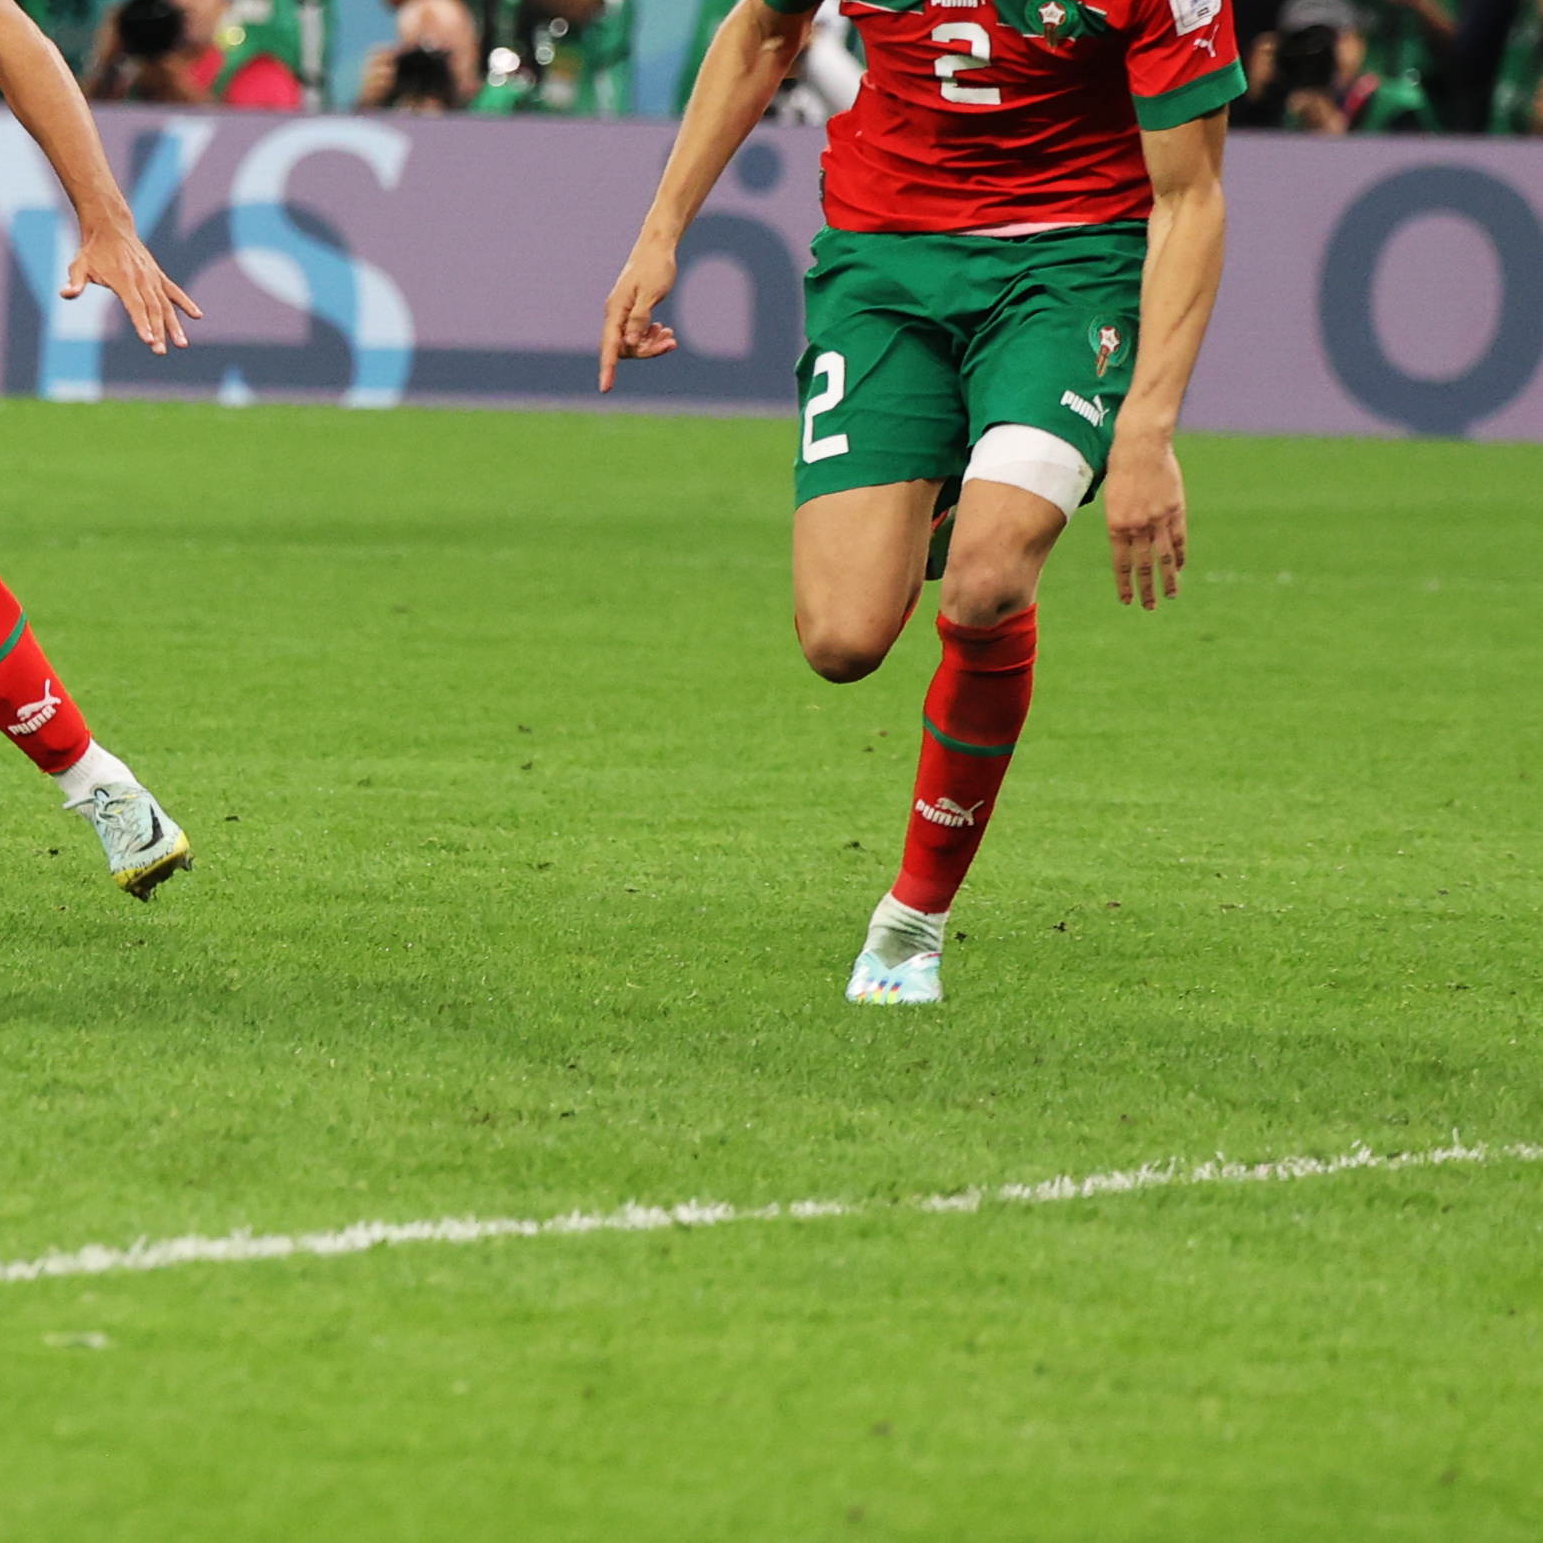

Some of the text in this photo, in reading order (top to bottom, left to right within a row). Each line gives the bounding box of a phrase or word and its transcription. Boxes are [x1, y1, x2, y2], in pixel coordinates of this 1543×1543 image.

[931, 21, 1001, 105] 2
[802, 351, 849, 464] 2
[1060, 390, 1101, 427] PUMA
[7, 705, 57, 735] PUMA
[915, 799, 965, 828] PUMA
